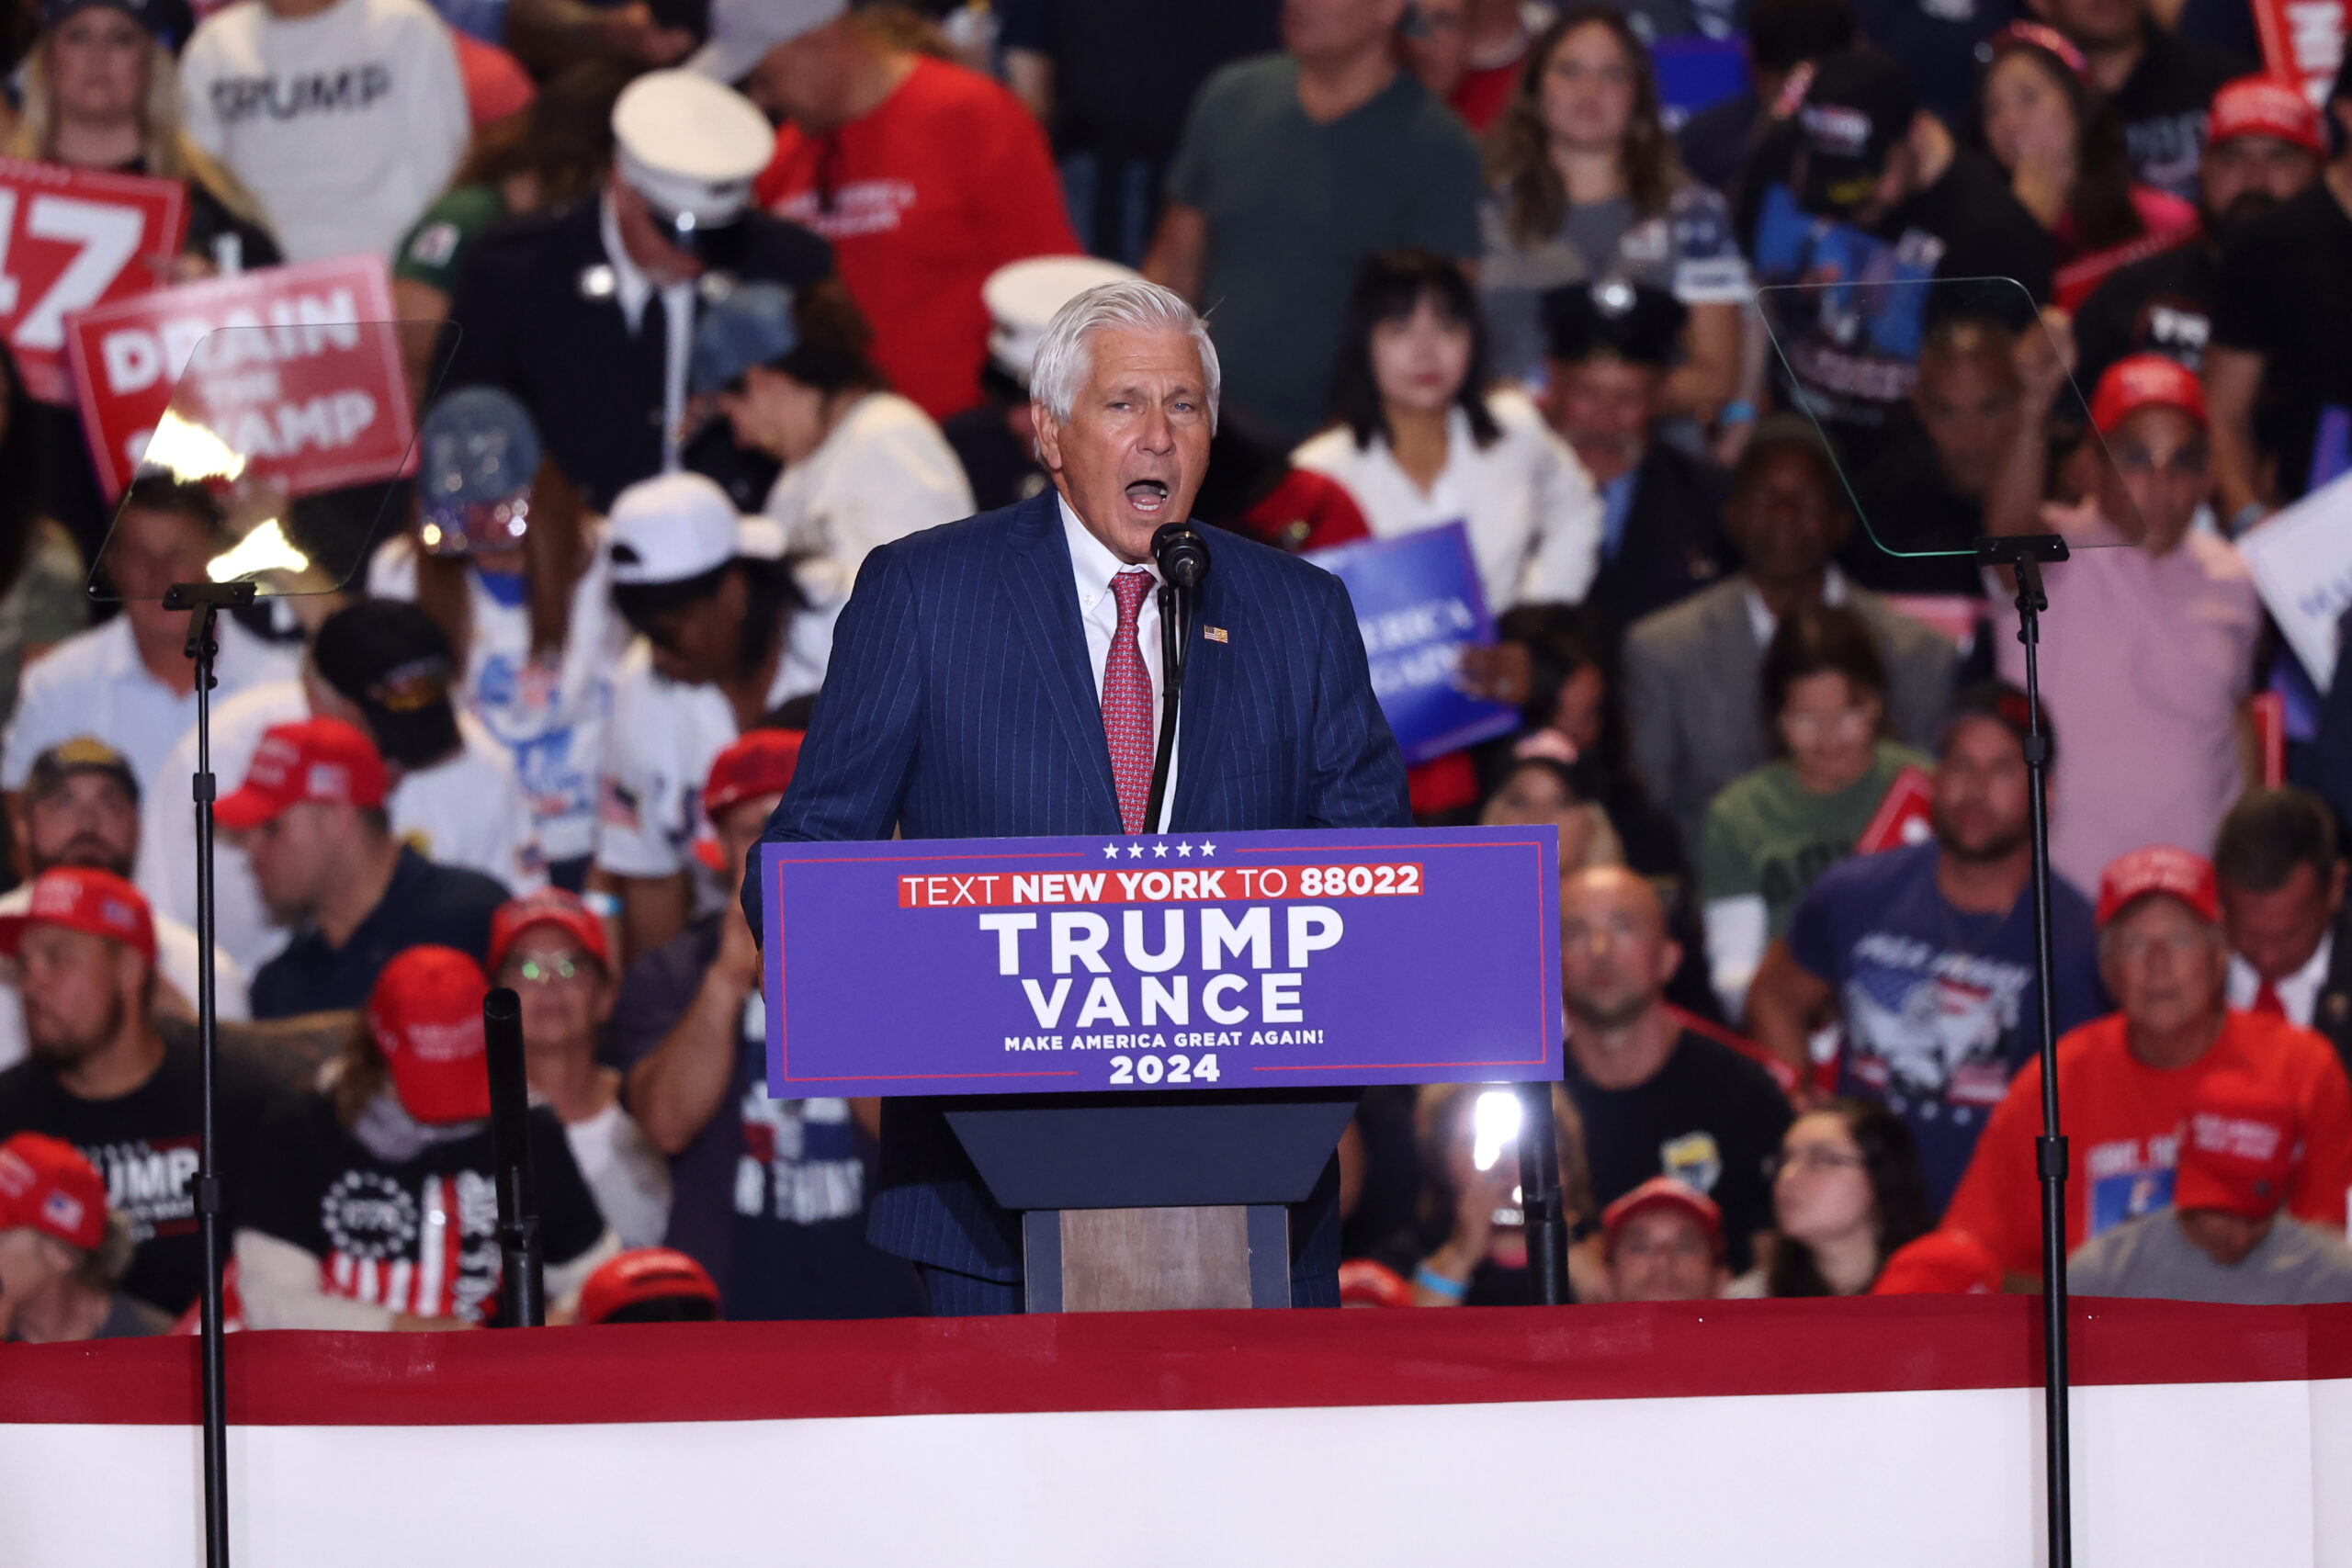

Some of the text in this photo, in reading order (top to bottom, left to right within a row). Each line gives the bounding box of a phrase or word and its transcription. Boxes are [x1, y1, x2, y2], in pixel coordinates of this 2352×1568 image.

[102, 288, 360, 396] DRAIN
[902, 864, 1420, 906] TEXT NEW YORK TO 88022
[978, 906, 1344, 976] TRUMP
[1021, 972, 1304, 1029] VANCE
[1004, 1030, 1324, 1052] MAKE AMERICA GREAT AGAIN!
[1109, 1054, 1220, 1085] 2024
[90, 1145, 199, 1207] UMP
